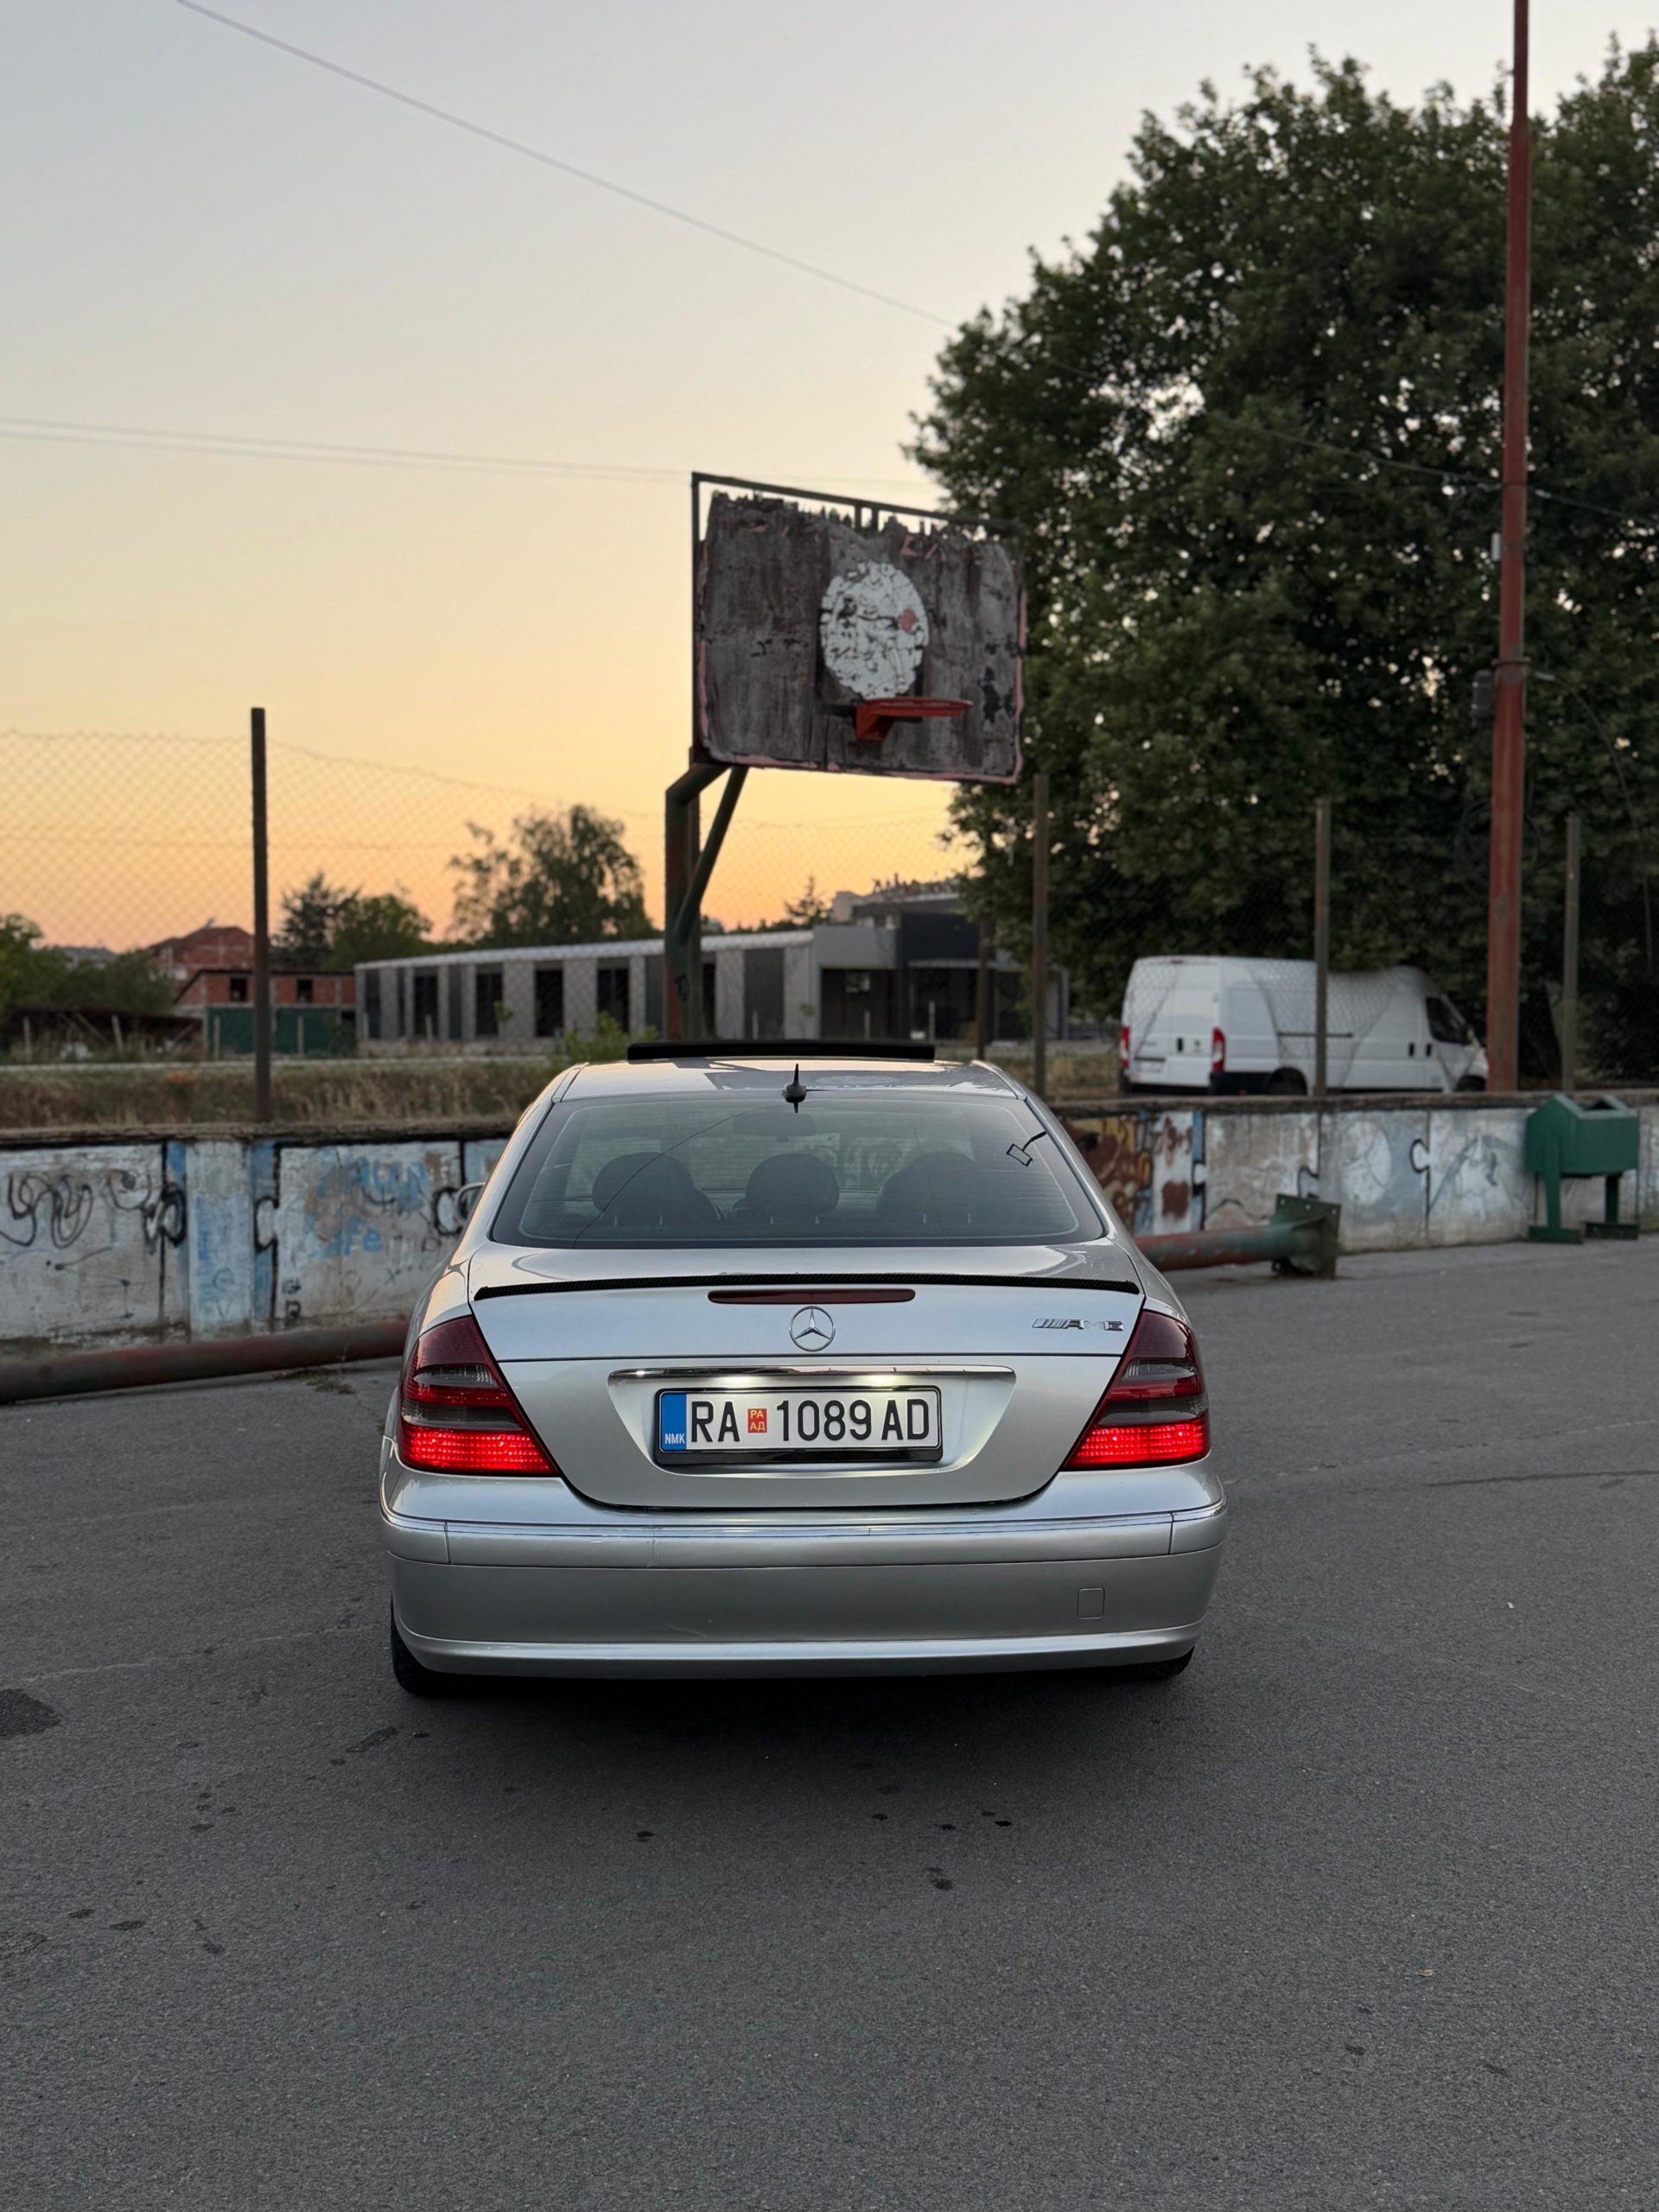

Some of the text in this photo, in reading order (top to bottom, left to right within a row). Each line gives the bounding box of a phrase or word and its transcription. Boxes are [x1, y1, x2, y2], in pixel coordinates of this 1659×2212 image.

[690, 1399, 930, 1442] RA 1089 AD
[664, 1433, 685, 1445] NMK
